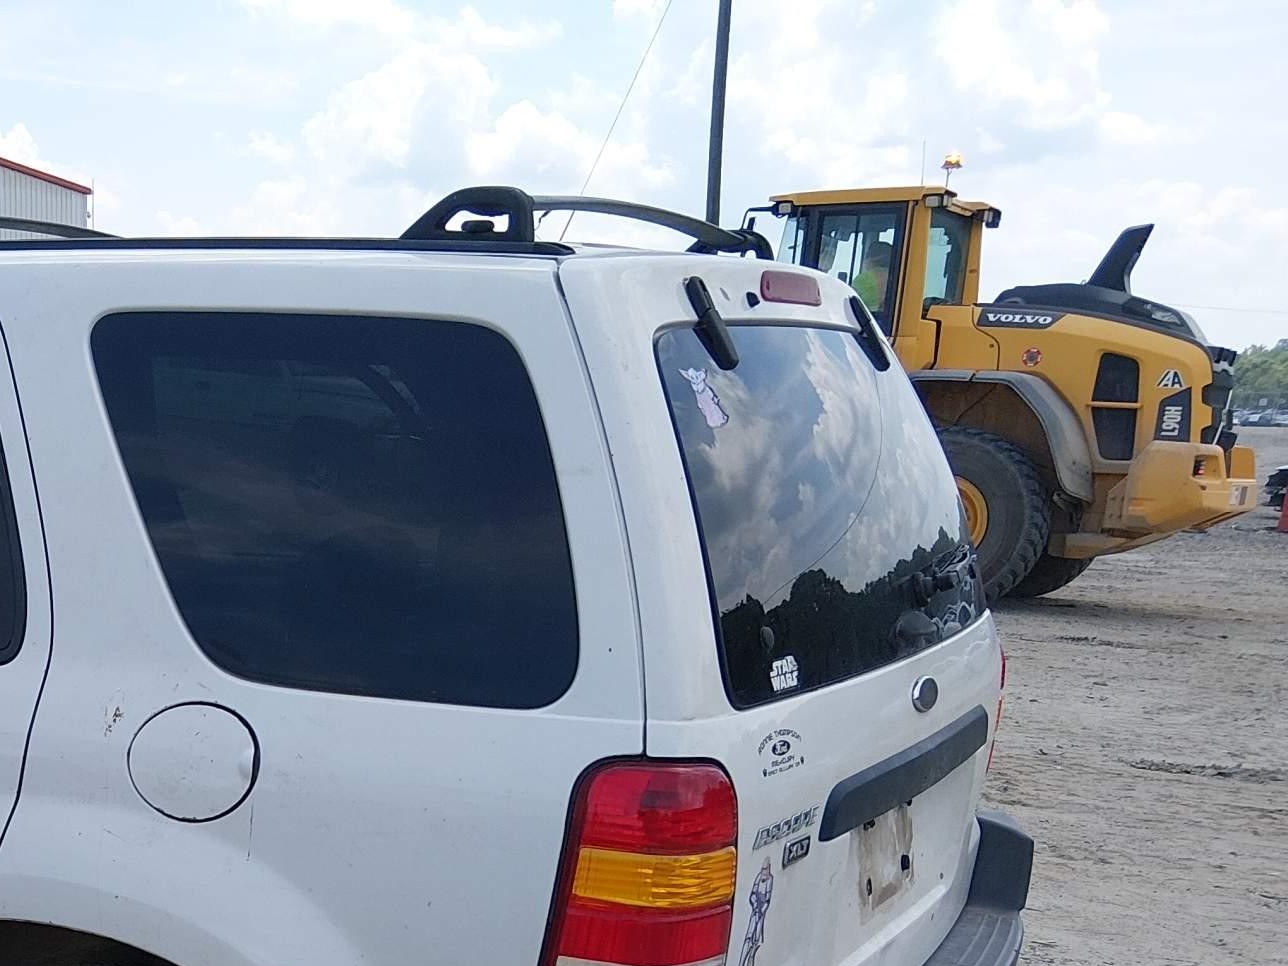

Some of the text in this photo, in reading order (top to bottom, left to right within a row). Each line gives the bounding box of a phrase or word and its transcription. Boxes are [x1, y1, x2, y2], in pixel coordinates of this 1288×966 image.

[986, 312, 1053, 325] VOLVO
[1160, 405, 1182, 436] L90H
[770, 655, 799, 677] STAR
[771, 670, 799, 692] WARS
